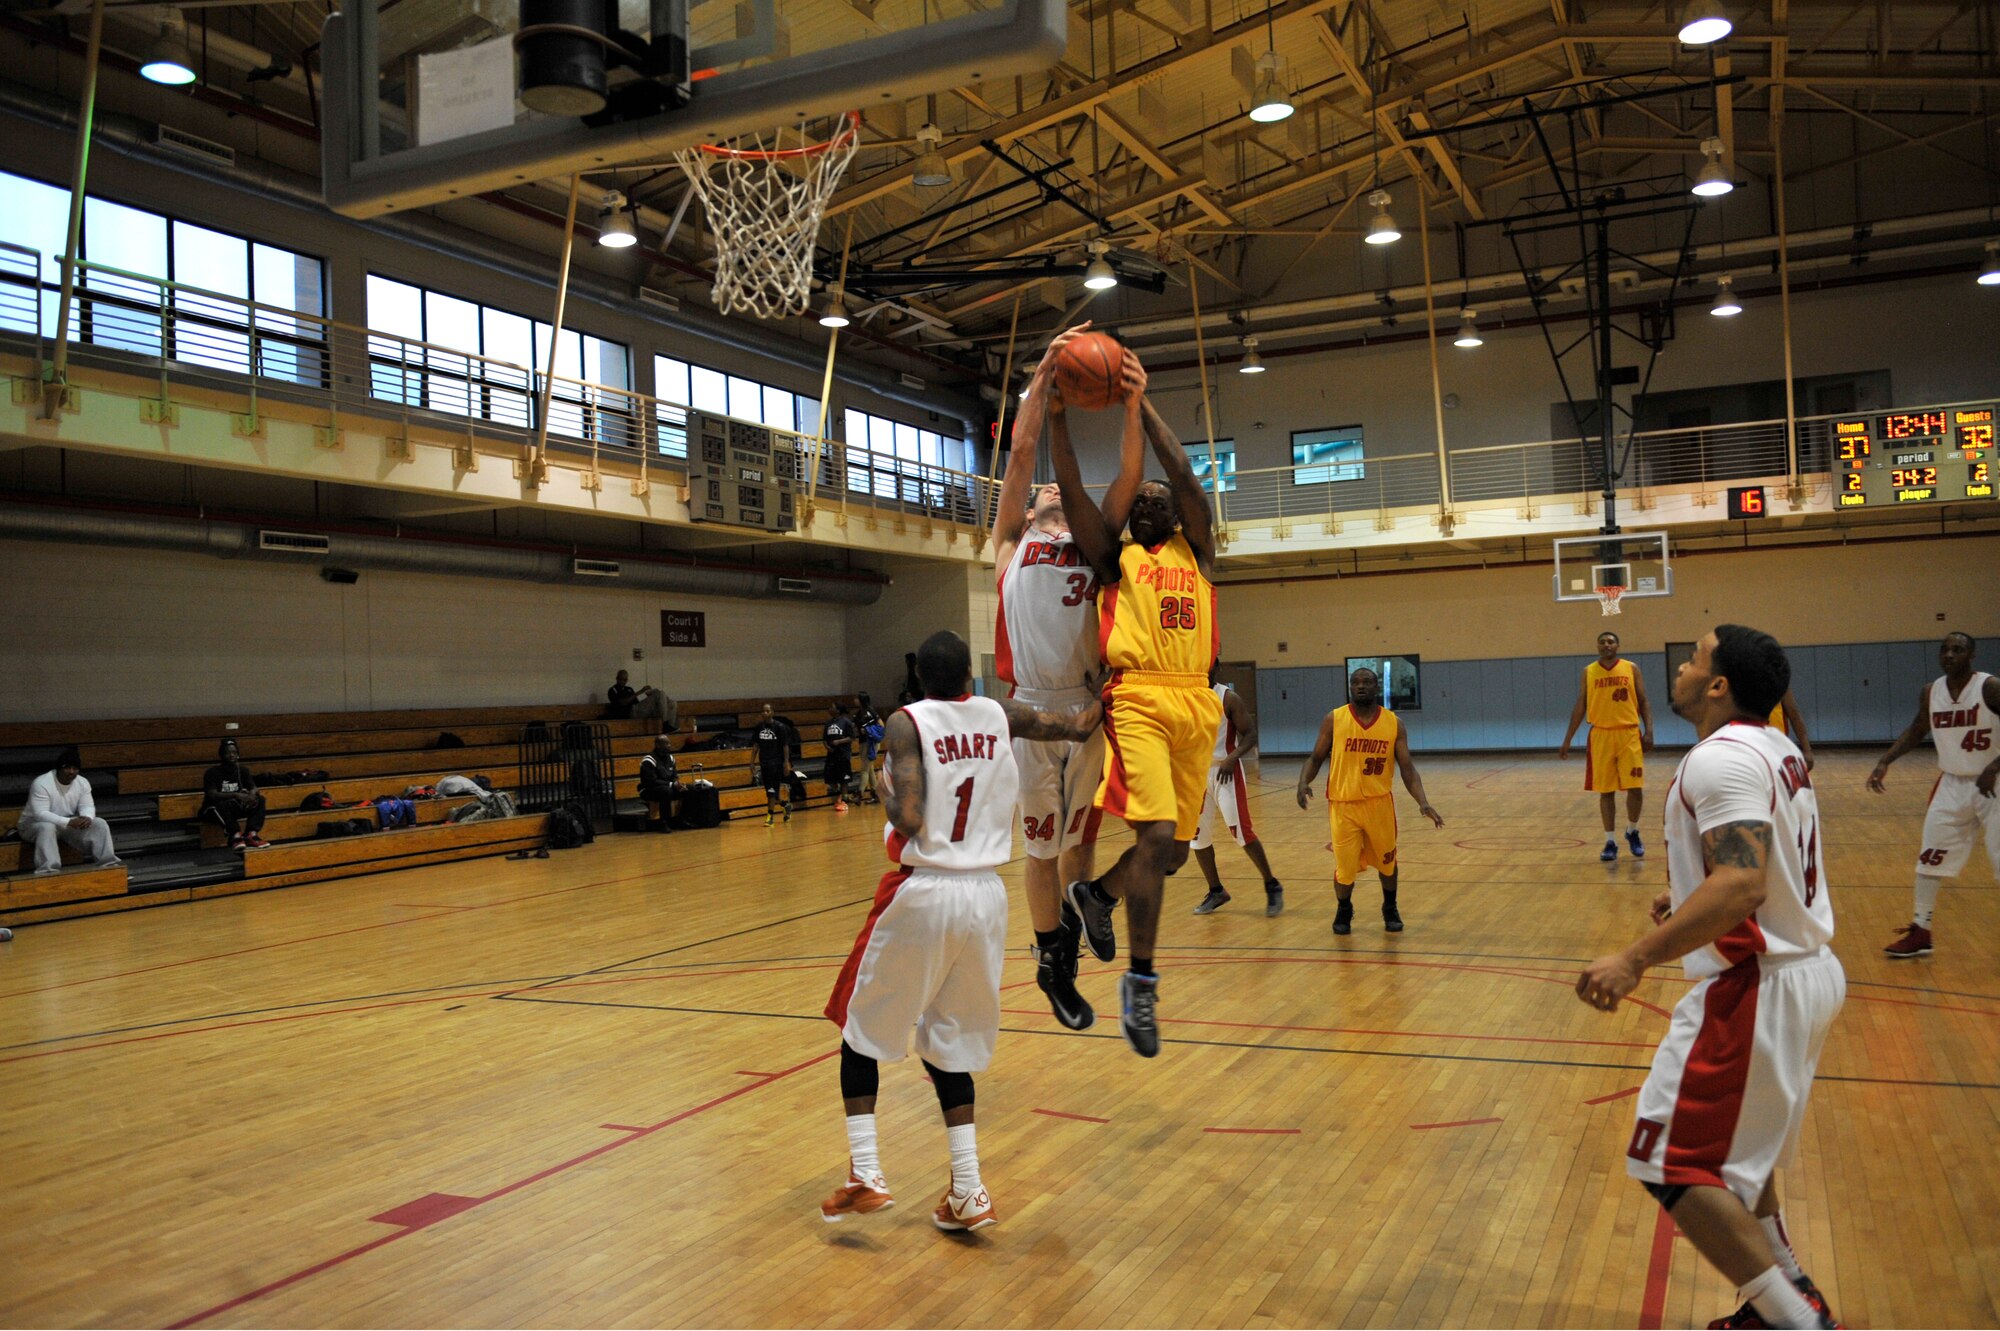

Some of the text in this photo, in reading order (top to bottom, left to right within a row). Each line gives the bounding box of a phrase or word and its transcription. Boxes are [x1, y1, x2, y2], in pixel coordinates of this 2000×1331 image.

[1886, 411, 1946, 438] 12:44
[1955, 411, 1991, 423] Guests
[1837, 422, 1865, 433] Home
[775, 434, 793, 449] Guests
[1961, 424, 1993, 450] 32
[1839, 436, 1870, 459] 37
[1897, 453, 1929, 464] period
[742, 469, 761, 482] period
[1975, 463, 1988, 481] 2
[1841, 494, 1865, 505] fouls
[1899, 489, 1932, 501] player
[1966, 485, 1992, 496] fouls
[1741, 490, 1762, 512] 16
[1135, 563, 1196, 593] PARIOTS
[667, 615, 699, 626] Court 1
[1160, 596, 1196, 630] 25
[669, 632, 698, 642] Side A
[1594, 676, 1629, 689] PATRIOTS
[933, 733, 998, 765] SMART
[1344, 738, 1389, 754] PATRIOTS
[1960, 728, 1992, 752] 45
[1362, 757, 1386, 775] 35
[951, 776, 975, 843] 1
[1023, 813, 1055, 841] 34
[1919, 848, 1948, 866] 45
